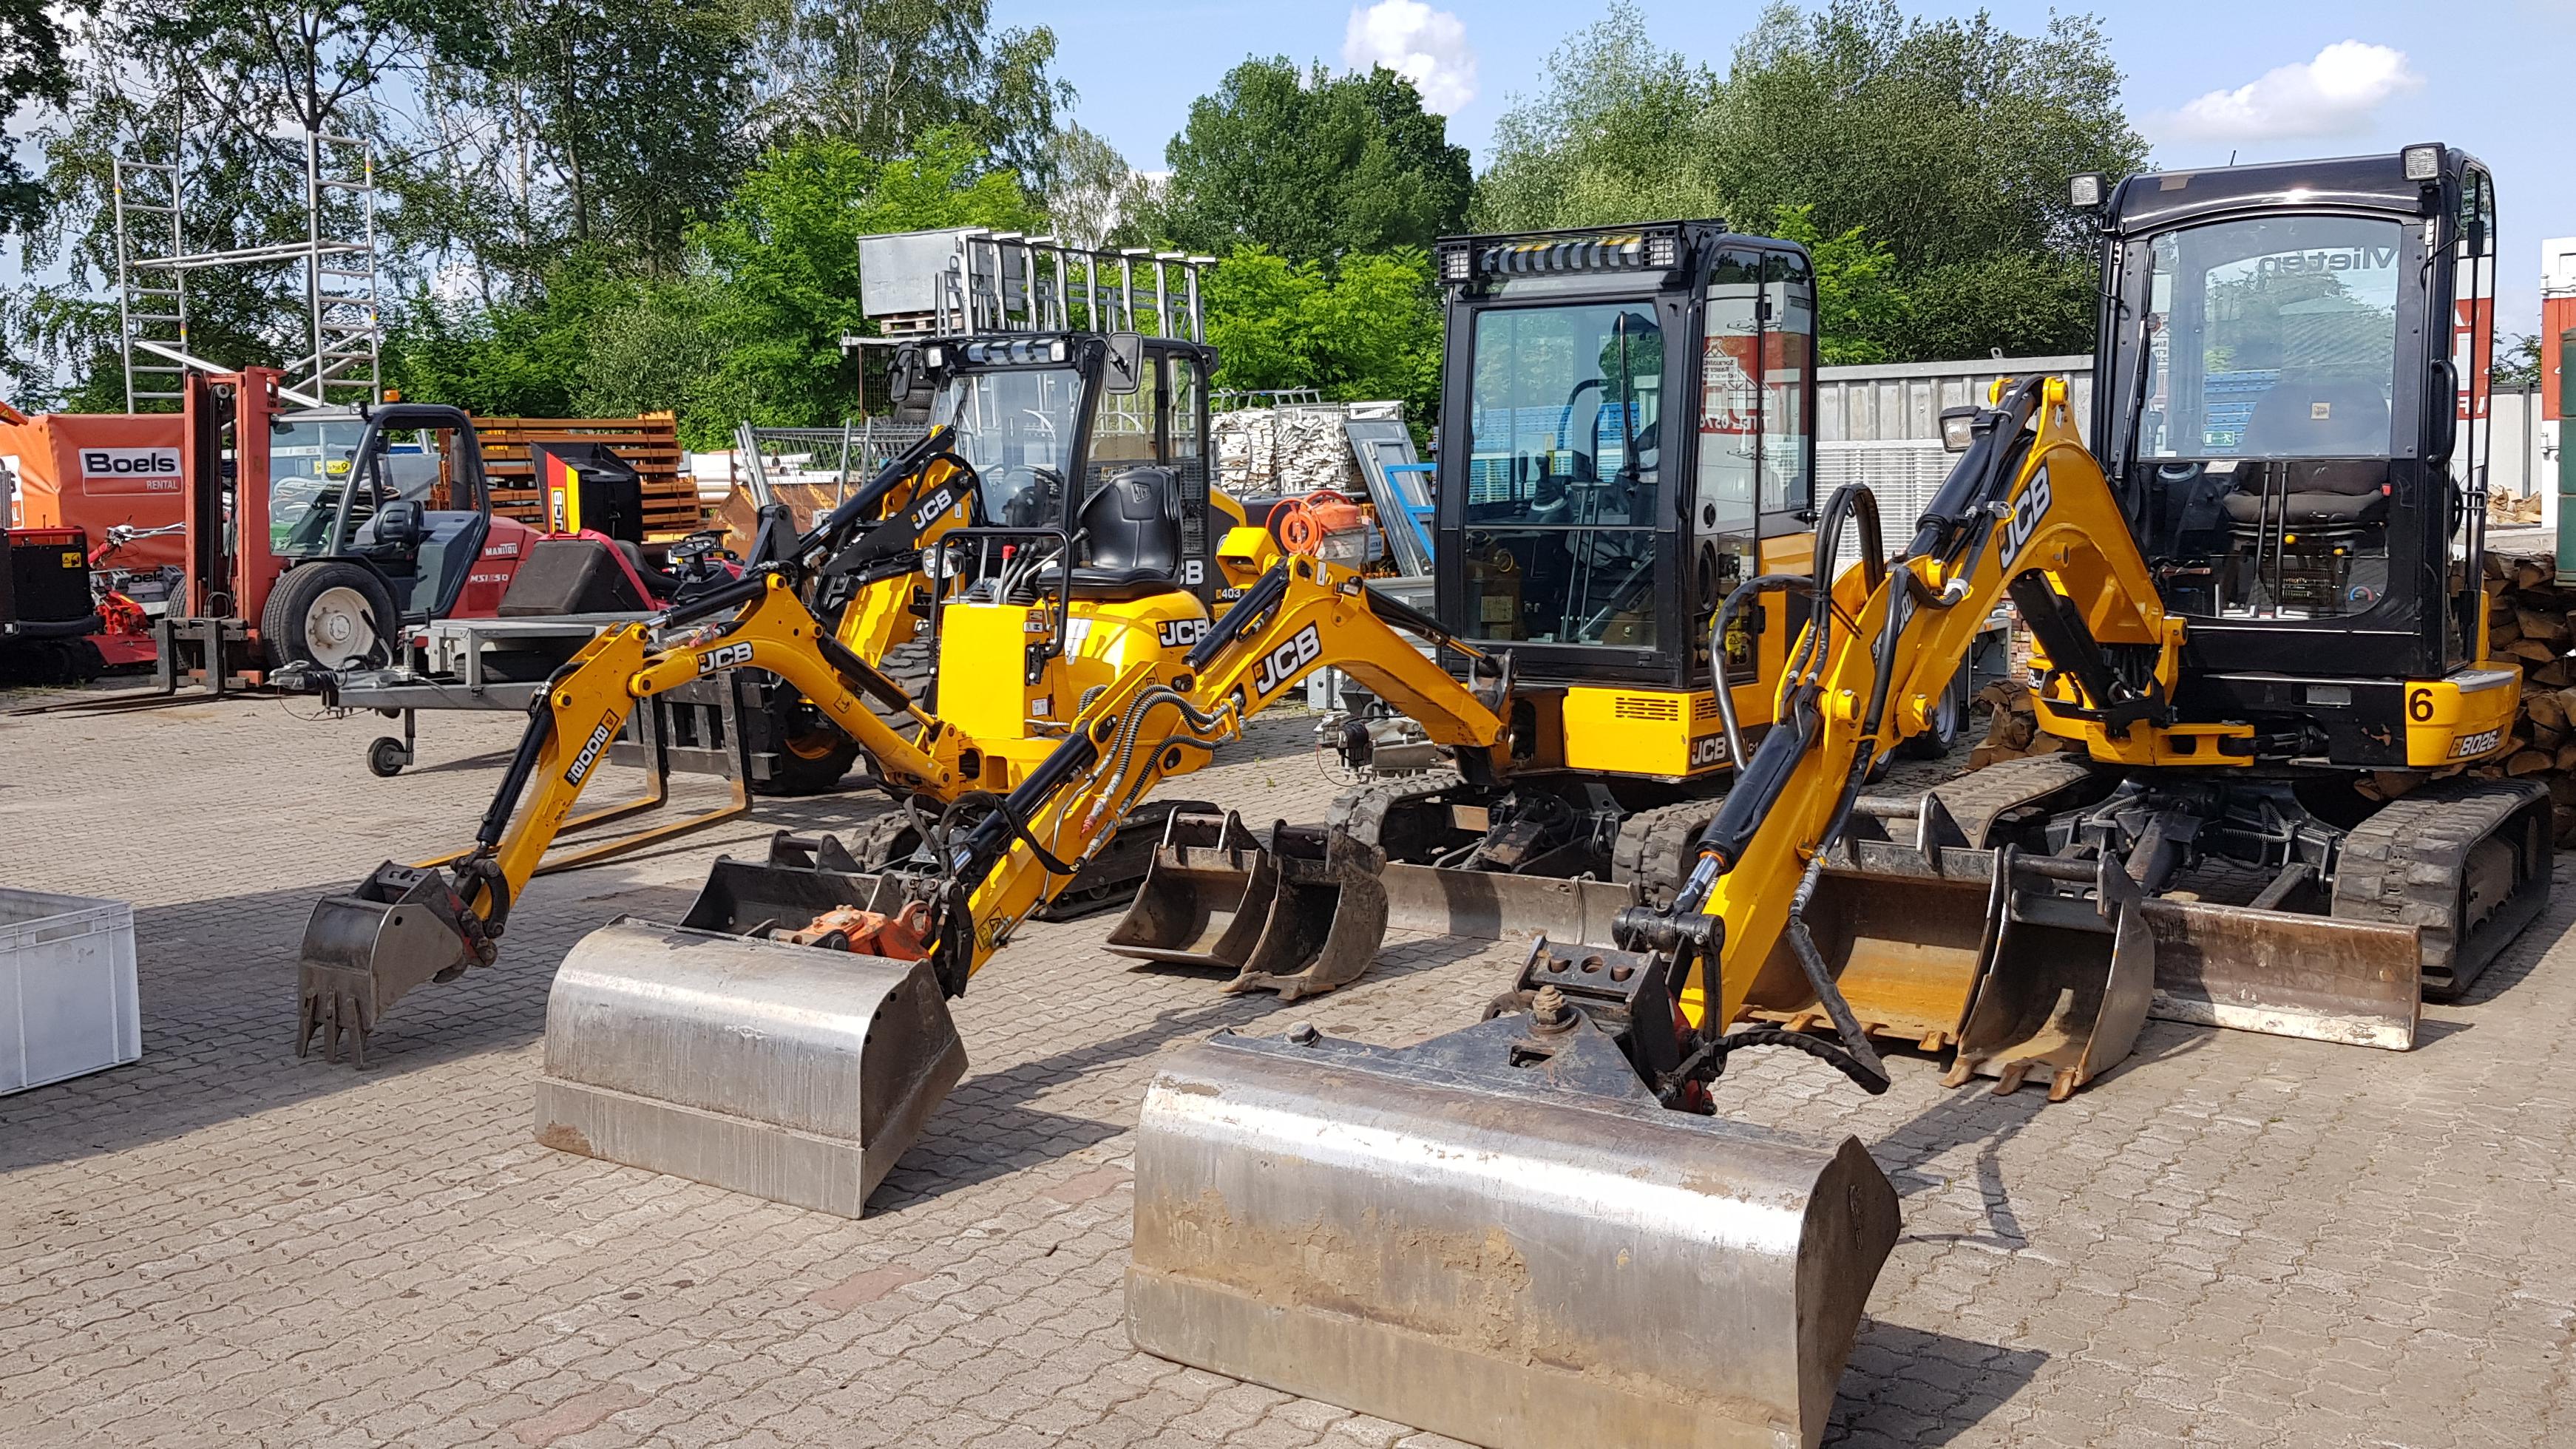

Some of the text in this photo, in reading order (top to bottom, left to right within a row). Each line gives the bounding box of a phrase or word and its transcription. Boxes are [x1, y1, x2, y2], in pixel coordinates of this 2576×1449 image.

[85, 452, 176, 473] Boels
[146, 480, 178, 490] RENTAL
[554, 491, 563, 531] JCB
[914, 489, 952, 529] JCB
[2001, 466, 2050, 569] JCB
[485, 543, 518, 556] MANITOU
[1221, 588, 1241, 599] 403
[1160, 620, 1207, 646] JCB
[699, 642, 753, 673] JCB
[1257, 626, 1320, 693] JCB
[2409, 688, 2434, 722] 6
[570, 725, 609, 778] 8008
[1691, 736, 1726, 765] JCB
[2458, 730, 2498, 756] 8026
